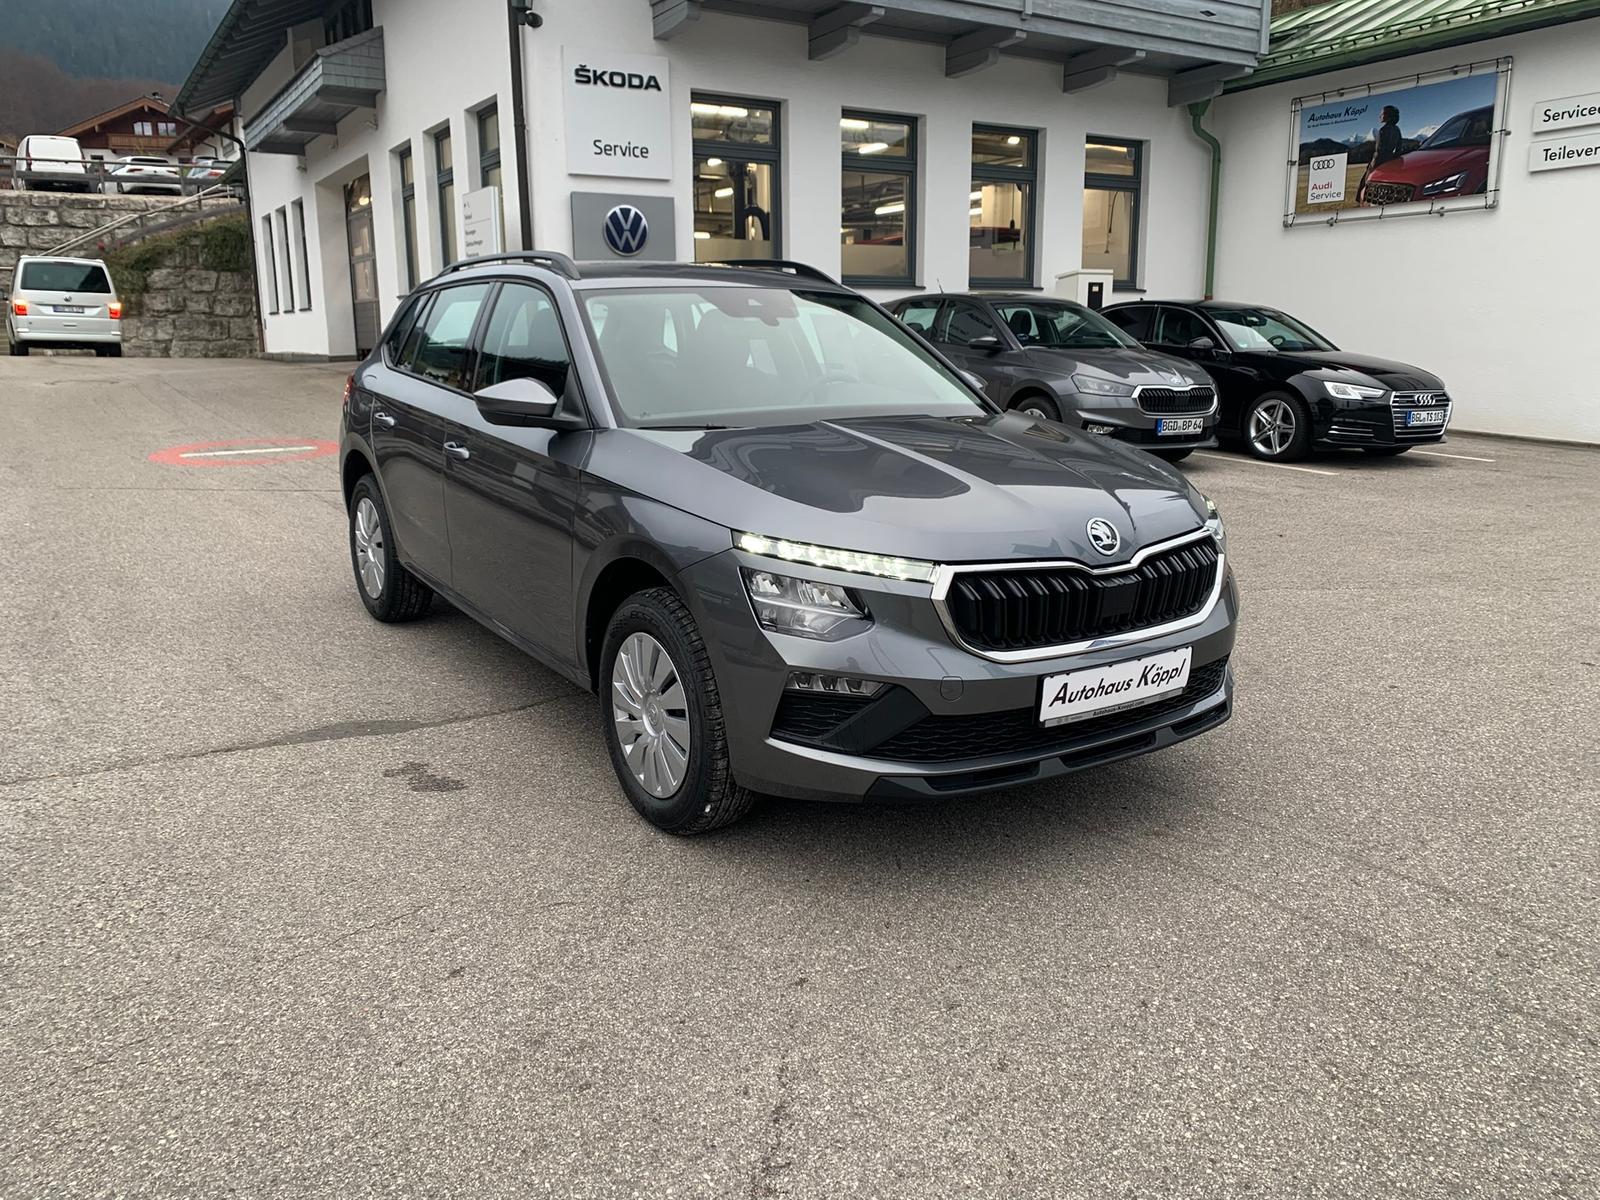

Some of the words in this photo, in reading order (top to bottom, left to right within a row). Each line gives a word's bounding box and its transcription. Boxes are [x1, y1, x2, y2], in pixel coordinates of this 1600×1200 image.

[574, 64, 662, 91] ŠKODA
[1307, 112, 1342, 123] Autohaus
[1344, 104, 1369, 117] Köppl
[1542, 104, 1600, 123] Service
[593, 139, 649, 159] Service
[1310, 191, 1342, 200] Service
[1311, 181, 1333, 191] Audi
[1162, 420, 1178, 431] BGD
[1048, 678, 1134, 708] Autohaus
[1136, 658, 1187, 688] Köppl
